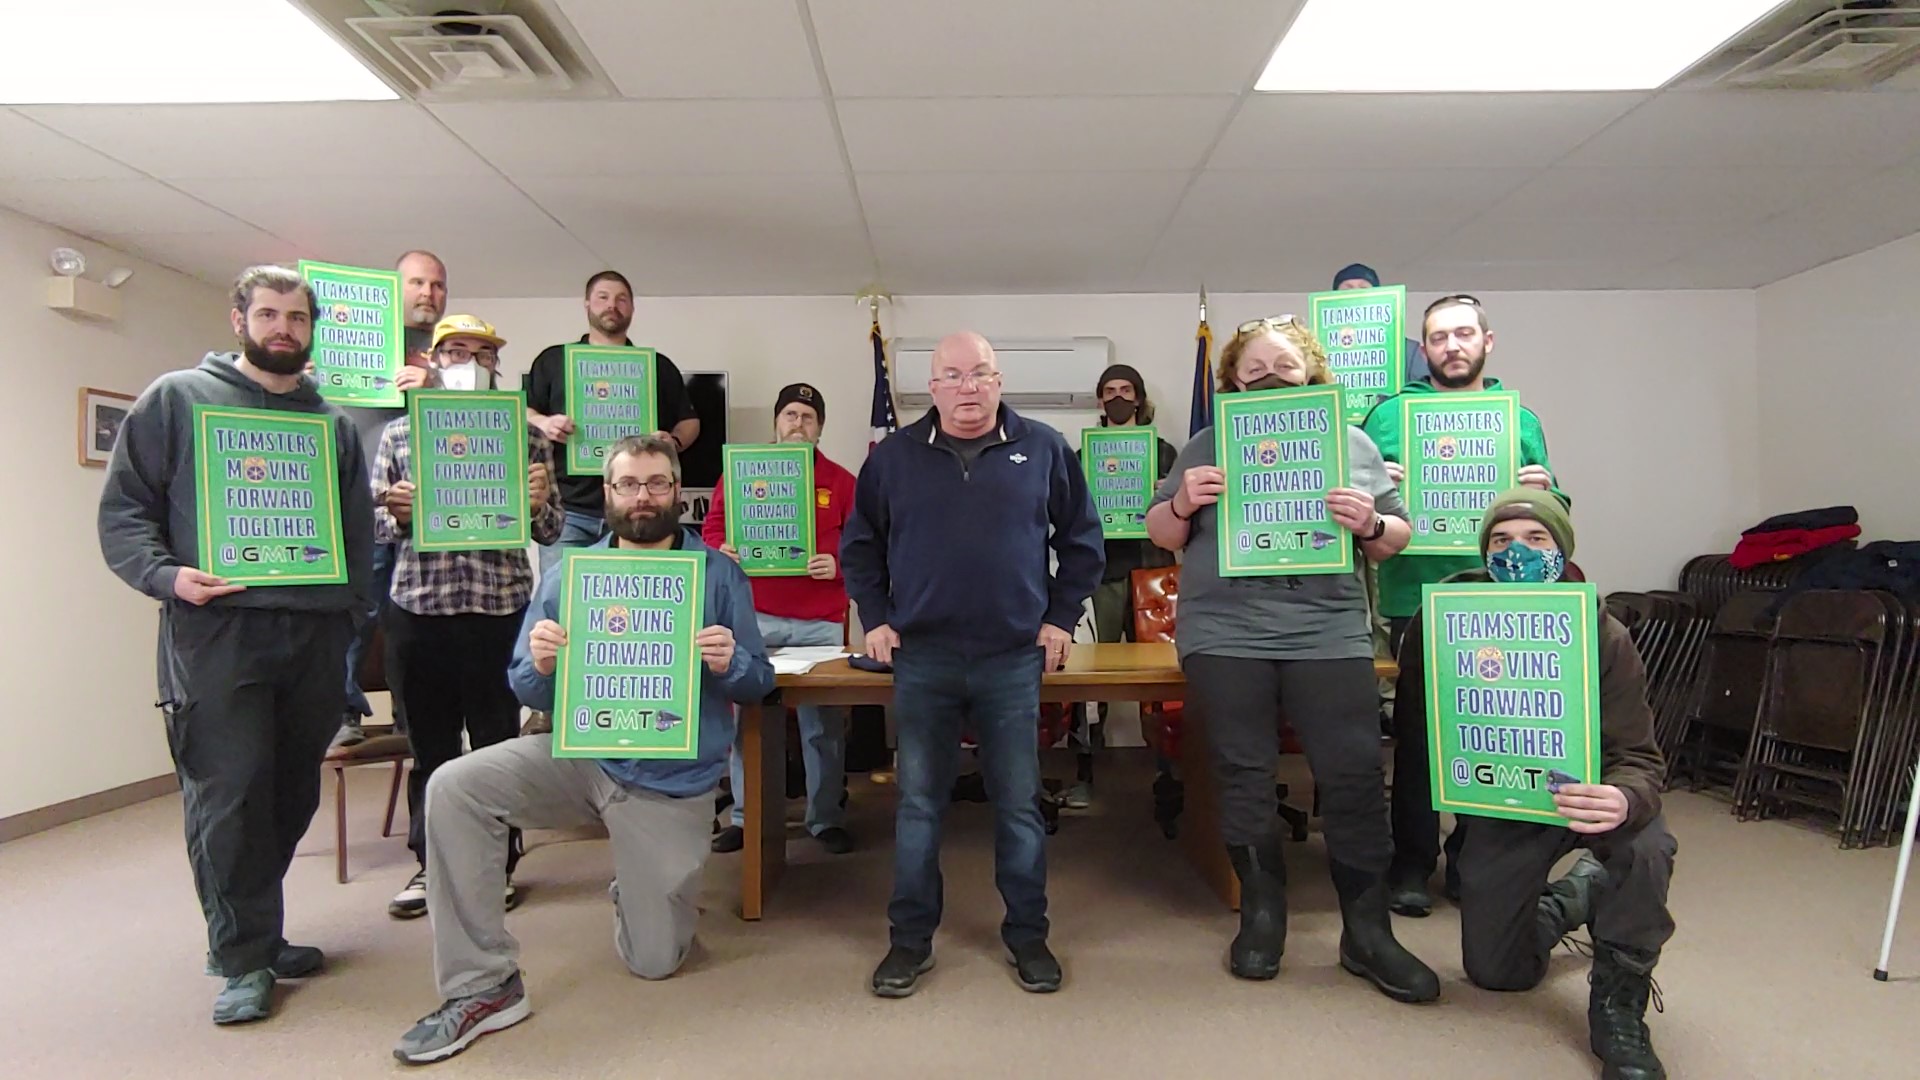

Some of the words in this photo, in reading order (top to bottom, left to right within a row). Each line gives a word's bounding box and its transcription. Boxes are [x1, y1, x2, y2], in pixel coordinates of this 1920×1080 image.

[314, 280, 389, 307] TEAMSTERS
[1321, 304, 1392, 327] TEAMSTERS
[320, 327, 385, 348] FORWARD
[322, 349, 385, 369] TOGETHER
[1327, 349, 1387, 367] FORWARD
[578, 361, 645, 378] TEAMSTERS
[1335, 371, 1387, 388] OGETHER
[426, 410, 512, 432] TEAMSTERS
[584, 403, 641, 418] FORWARD
[1232, 408, 1329, 441] TEAMSTERS
[1415, 411, 1504, 436] TEAMSTERS
[215, 428, 318, 458] TEAMSTERS
[434, 462, 507, 481] FORWARD
[736, 460, 802, 480] TEAMSTERS
[1422, 464, 1497, 483] FORWARD
[1242, 469, 1324, 495] FORWARD
[226, 487, 314, 509] FORWARD
[435, 488, 508, 506] TOGETHER
[742, 503, 798, 520] FORWARD
[1242, 499, 1327, 524] TOGETHER
[227, 516, 317, 538] TOGETHER
[743, 524, 800, 541] TOGETHER
[581, 574, 686, 604] TEAMSTERS
[1444, 612, 1573, 646] TEAMSTERS
[585, 641, 675, 666] FORWARD
[584, 674, 673, 700] TOGETHER
[1456, 687, 1564, 719] FORWARD
[1457, 724, 1566, 759] TOGETHER
